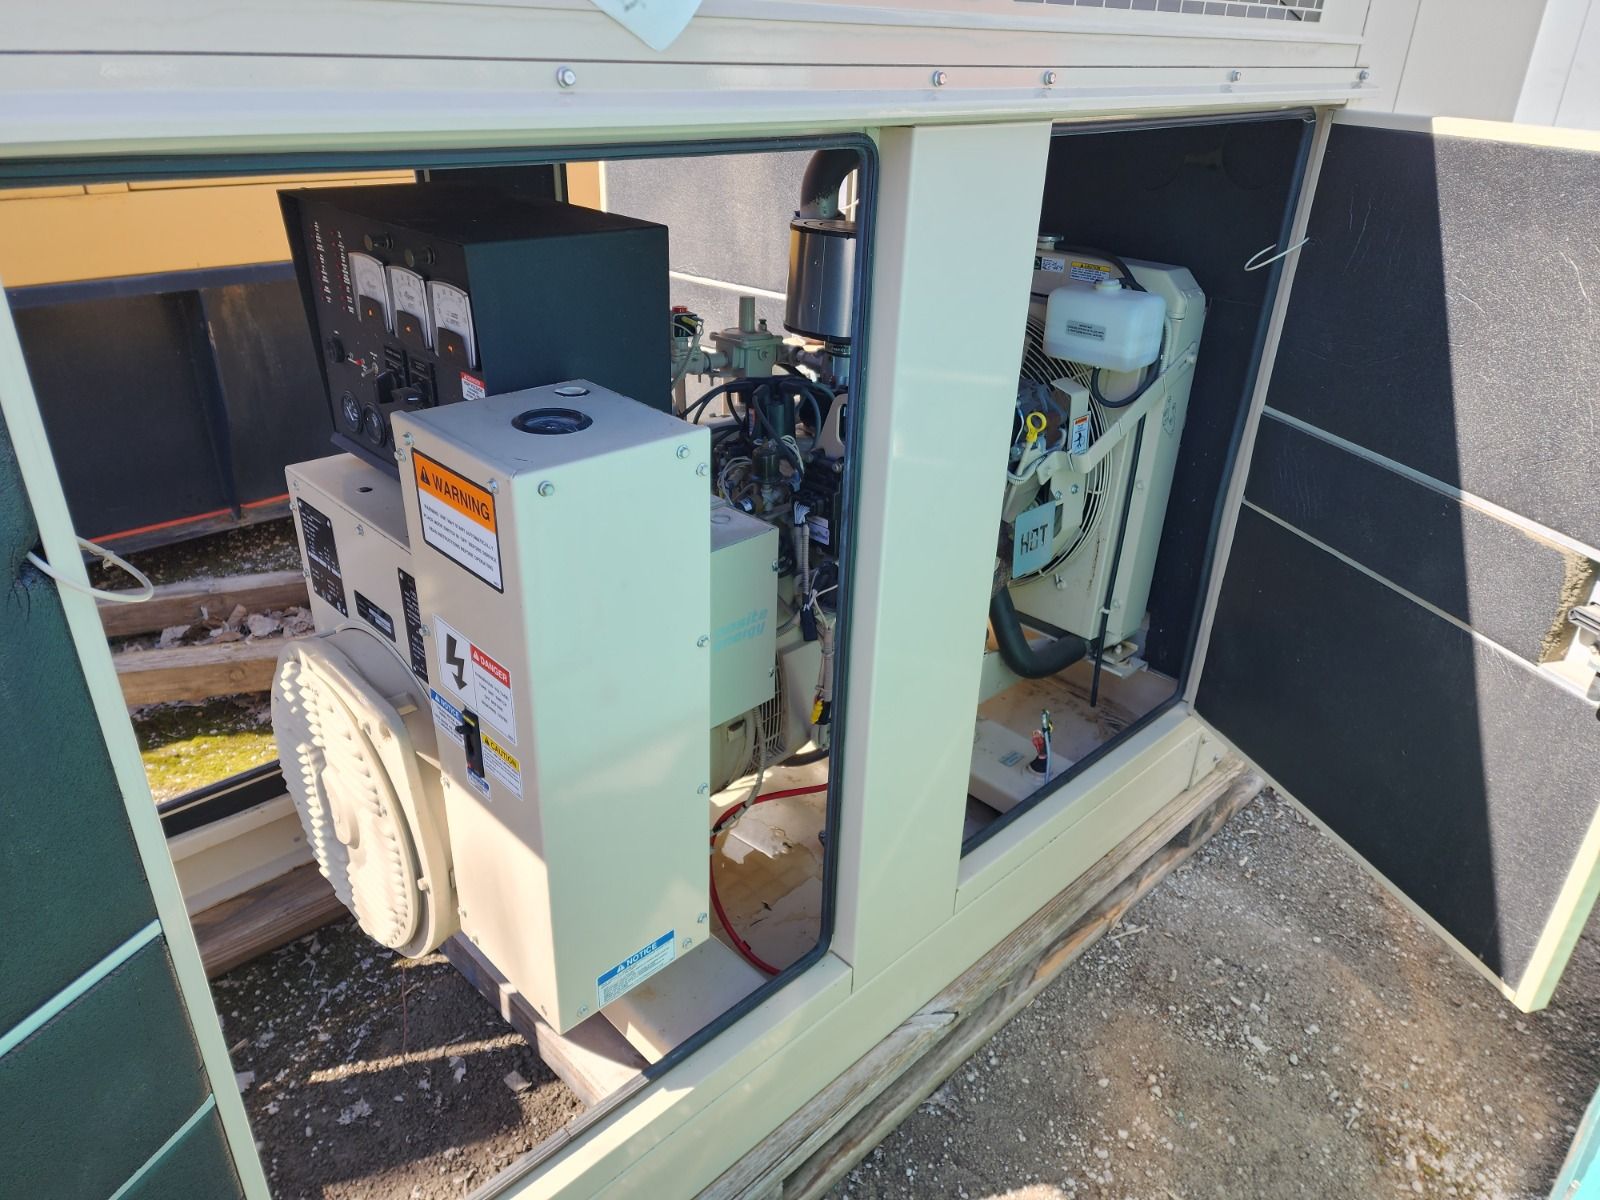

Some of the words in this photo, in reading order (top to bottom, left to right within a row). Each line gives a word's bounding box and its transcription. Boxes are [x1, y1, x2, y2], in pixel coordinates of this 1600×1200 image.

[432, 473, 490, 522] WARNING
[1020, 524, 1048, 555] HOT
[480, 655, 508, 683] DANGER
[490, 742, 517, 769] CAUTION
[626, 942, 658, 967] NOTICE
